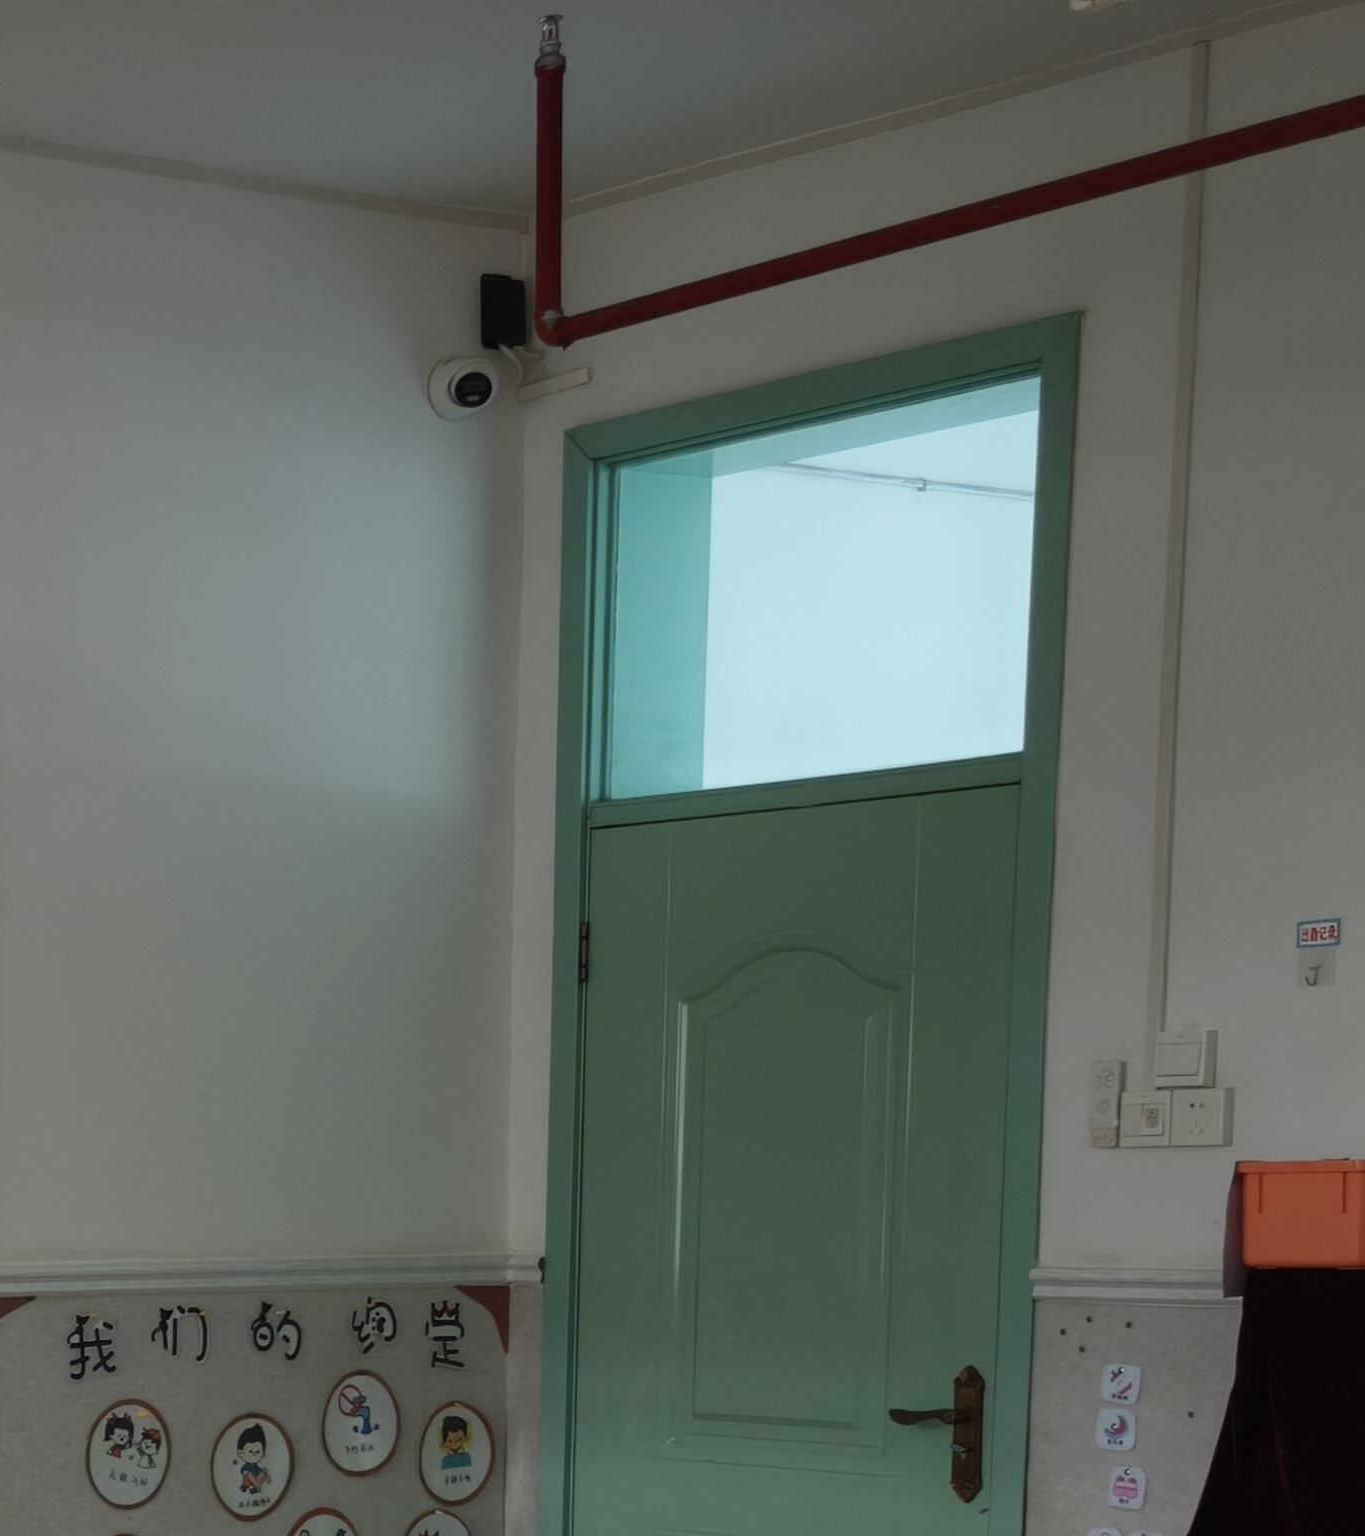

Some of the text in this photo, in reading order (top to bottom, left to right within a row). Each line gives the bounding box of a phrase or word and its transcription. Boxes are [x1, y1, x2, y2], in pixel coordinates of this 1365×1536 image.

[67, 1297, 466, 1379] 我们的约定
